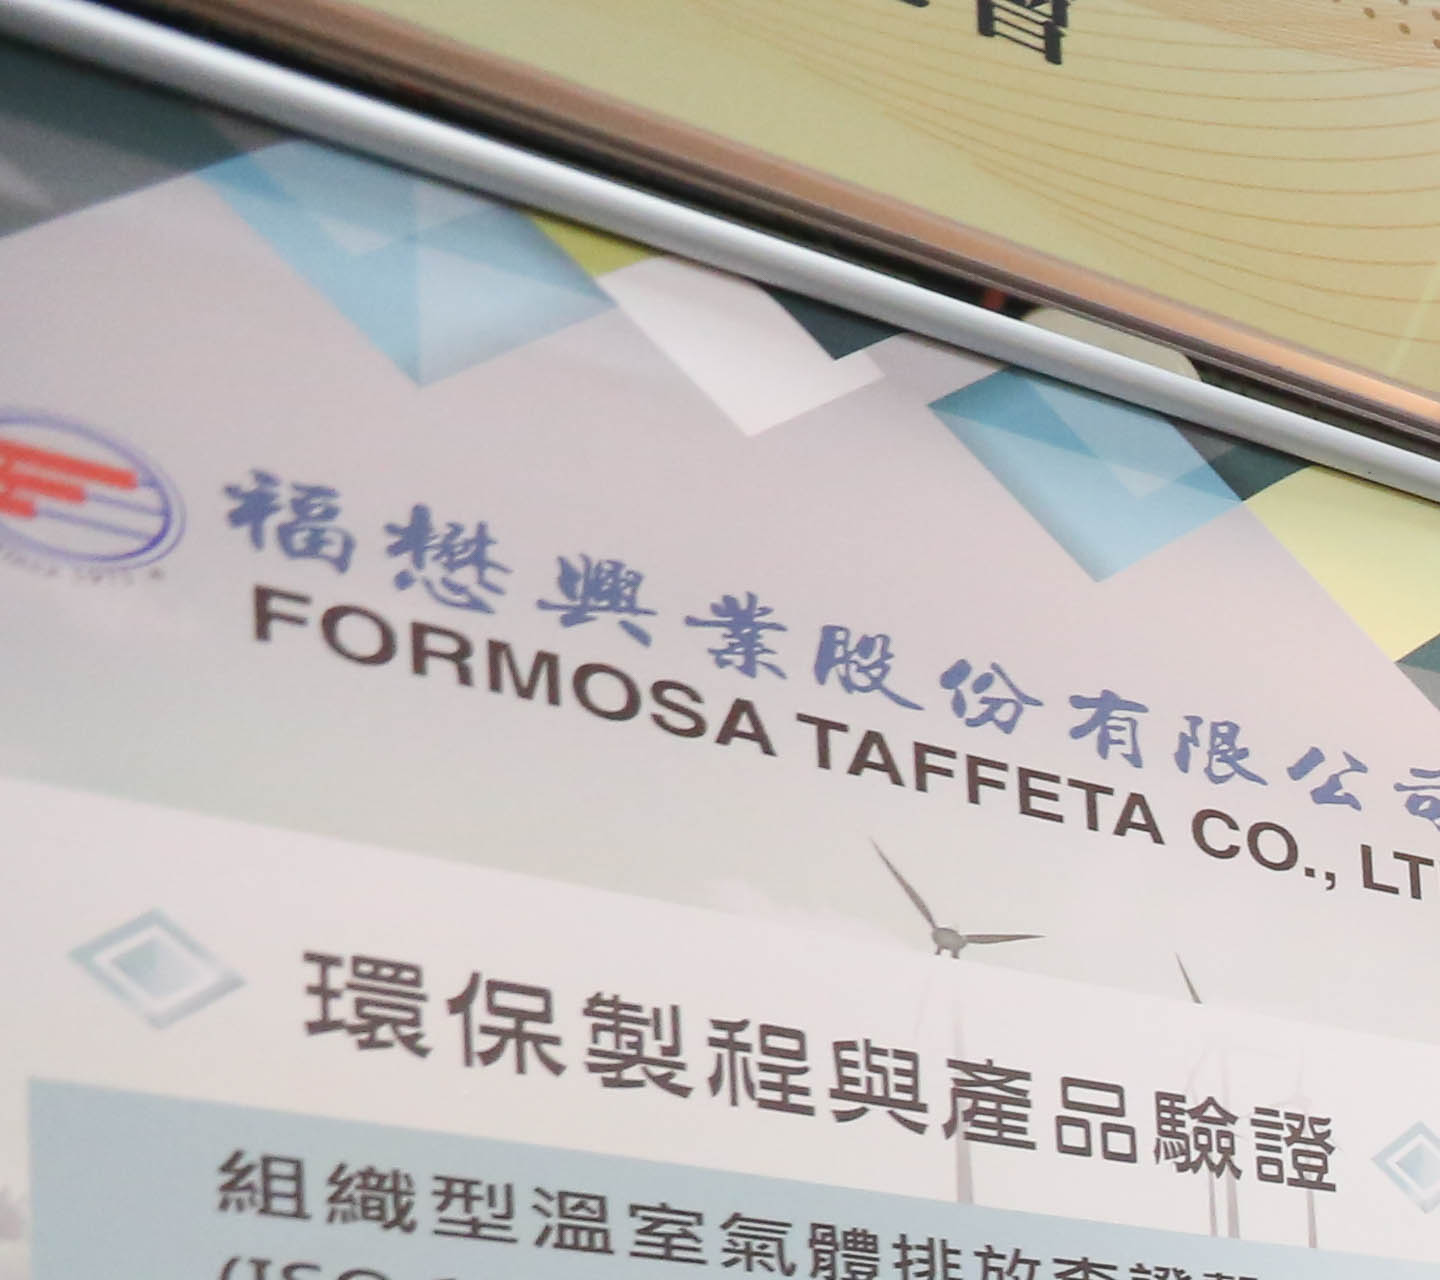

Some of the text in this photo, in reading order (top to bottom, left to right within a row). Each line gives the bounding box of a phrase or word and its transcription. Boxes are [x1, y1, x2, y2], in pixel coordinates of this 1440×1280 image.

[252, 583, 775, 761] FORMOSA
[813, 716, 1167, 848] TAFFETA
[1190, 808, 1340, 898] CO.,
[302, 949, 1339, 1192] 環保製程與產品驗證
